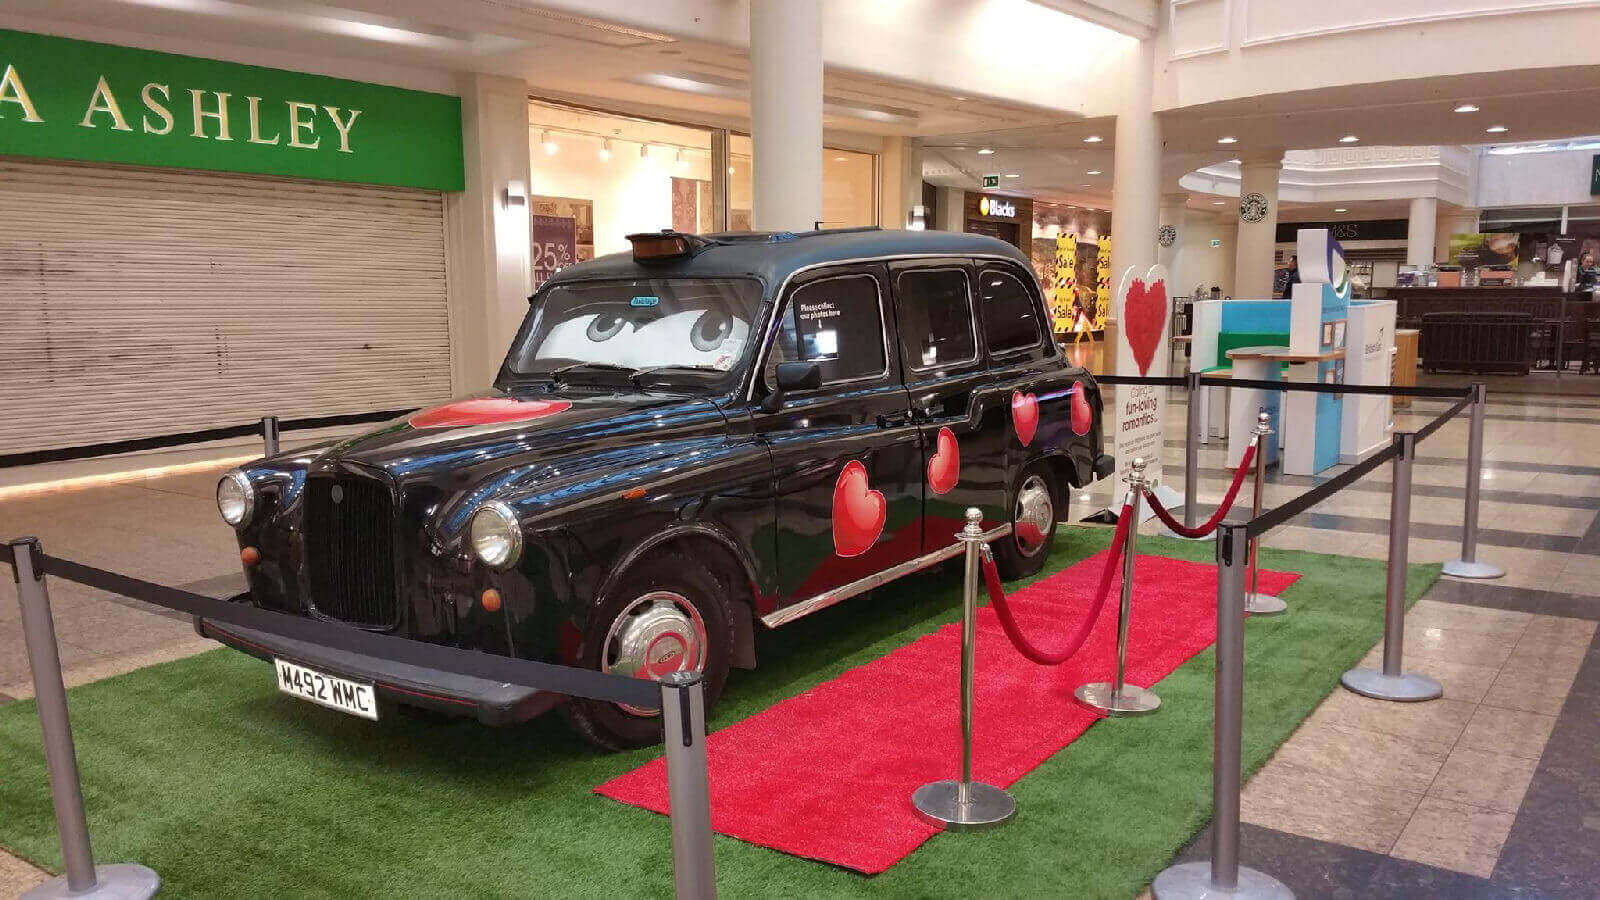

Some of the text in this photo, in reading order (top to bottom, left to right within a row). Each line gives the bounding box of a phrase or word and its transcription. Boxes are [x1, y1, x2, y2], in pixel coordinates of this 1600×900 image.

[78, 74, 363, 153] ASHLEY
[990, 199, 1015, 218] Blacks
[1058, 253, 1074, 269] Sale
[1057, 302, 1072, 318] Sale
[1125, 397, 1158, 416] fun-loving
[282, 664, 369, 711] M492 WMC
